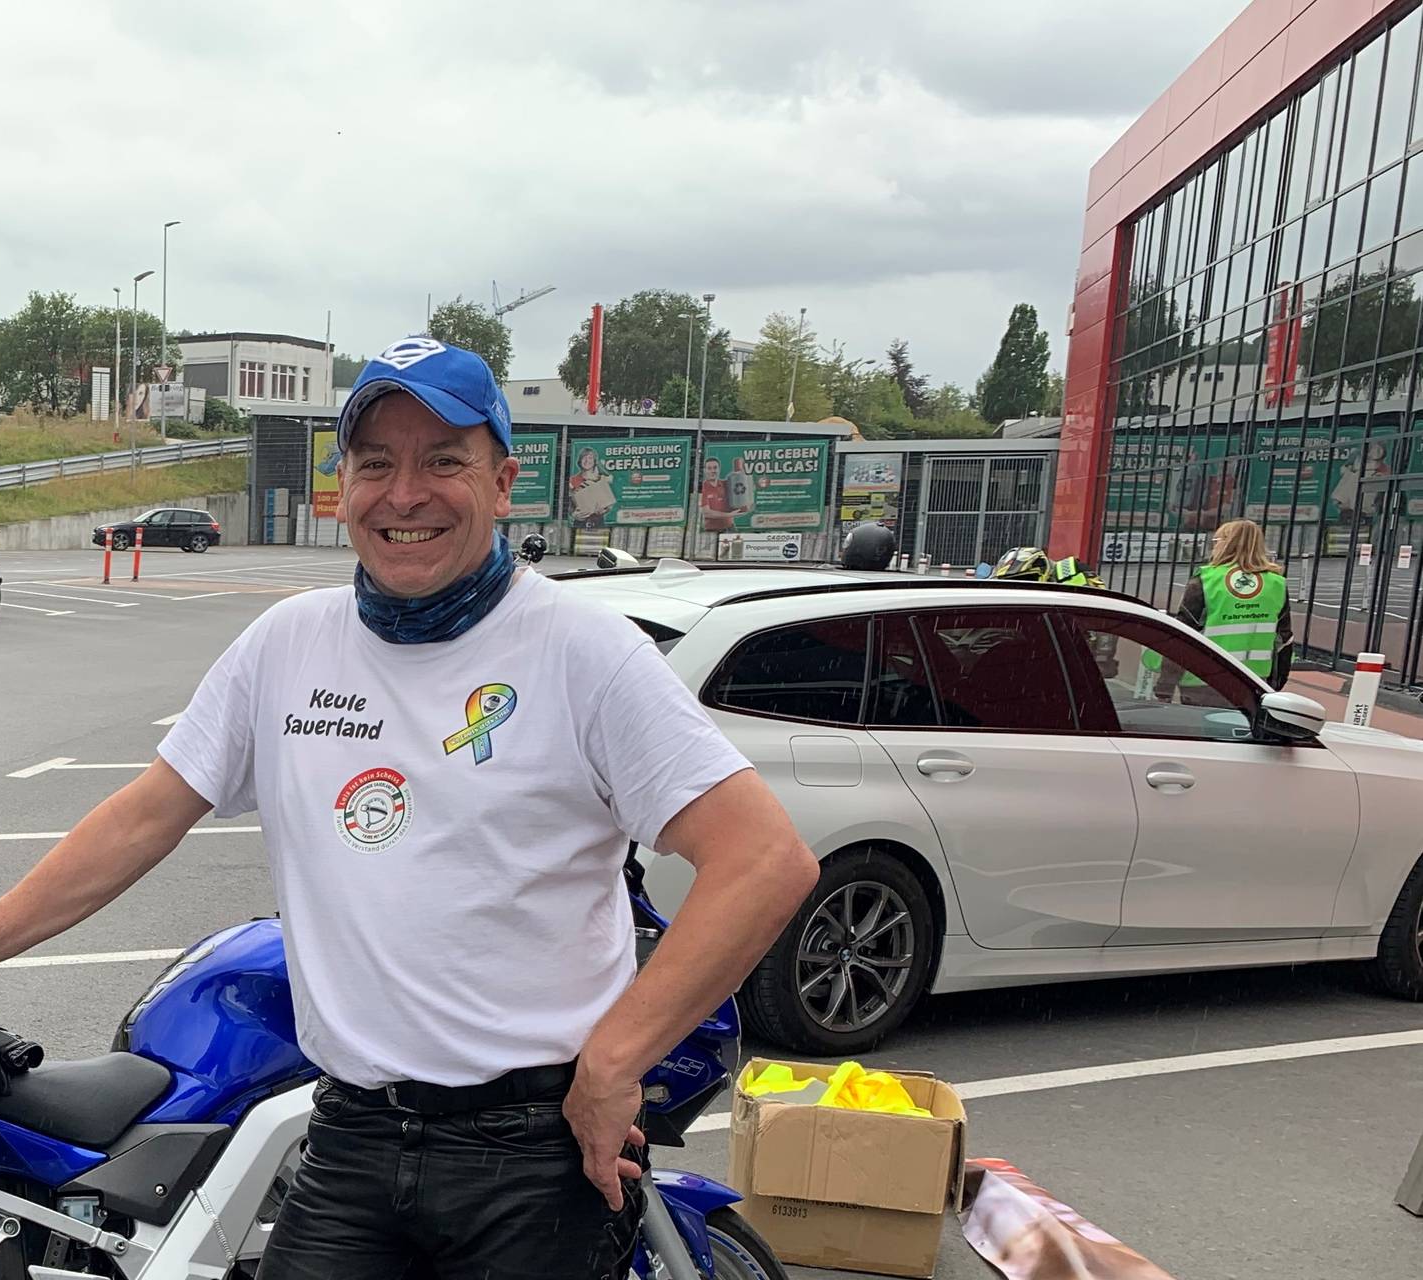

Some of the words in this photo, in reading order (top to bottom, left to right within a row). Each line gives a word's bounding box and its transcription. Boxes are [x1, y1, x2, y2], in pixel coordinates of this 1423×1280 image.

[524, 443, 549, 453] NUR
[605, 444, 682, 456] BEFÖRDERUNG
[743, 449, 772, 461] WIR
[775, 447, 819, 460] GEBEN
[605, 456, 682, 471] GEFÄLLIG?
[744, 460, 819, 474] VOLLGAS!
[309, 688, 367, 712] Keule
[283, 714, 384, 741] Sauerland
[375, 770, 401, 785] Scheiss
[772, 1204, 808, 1219] 6133913
